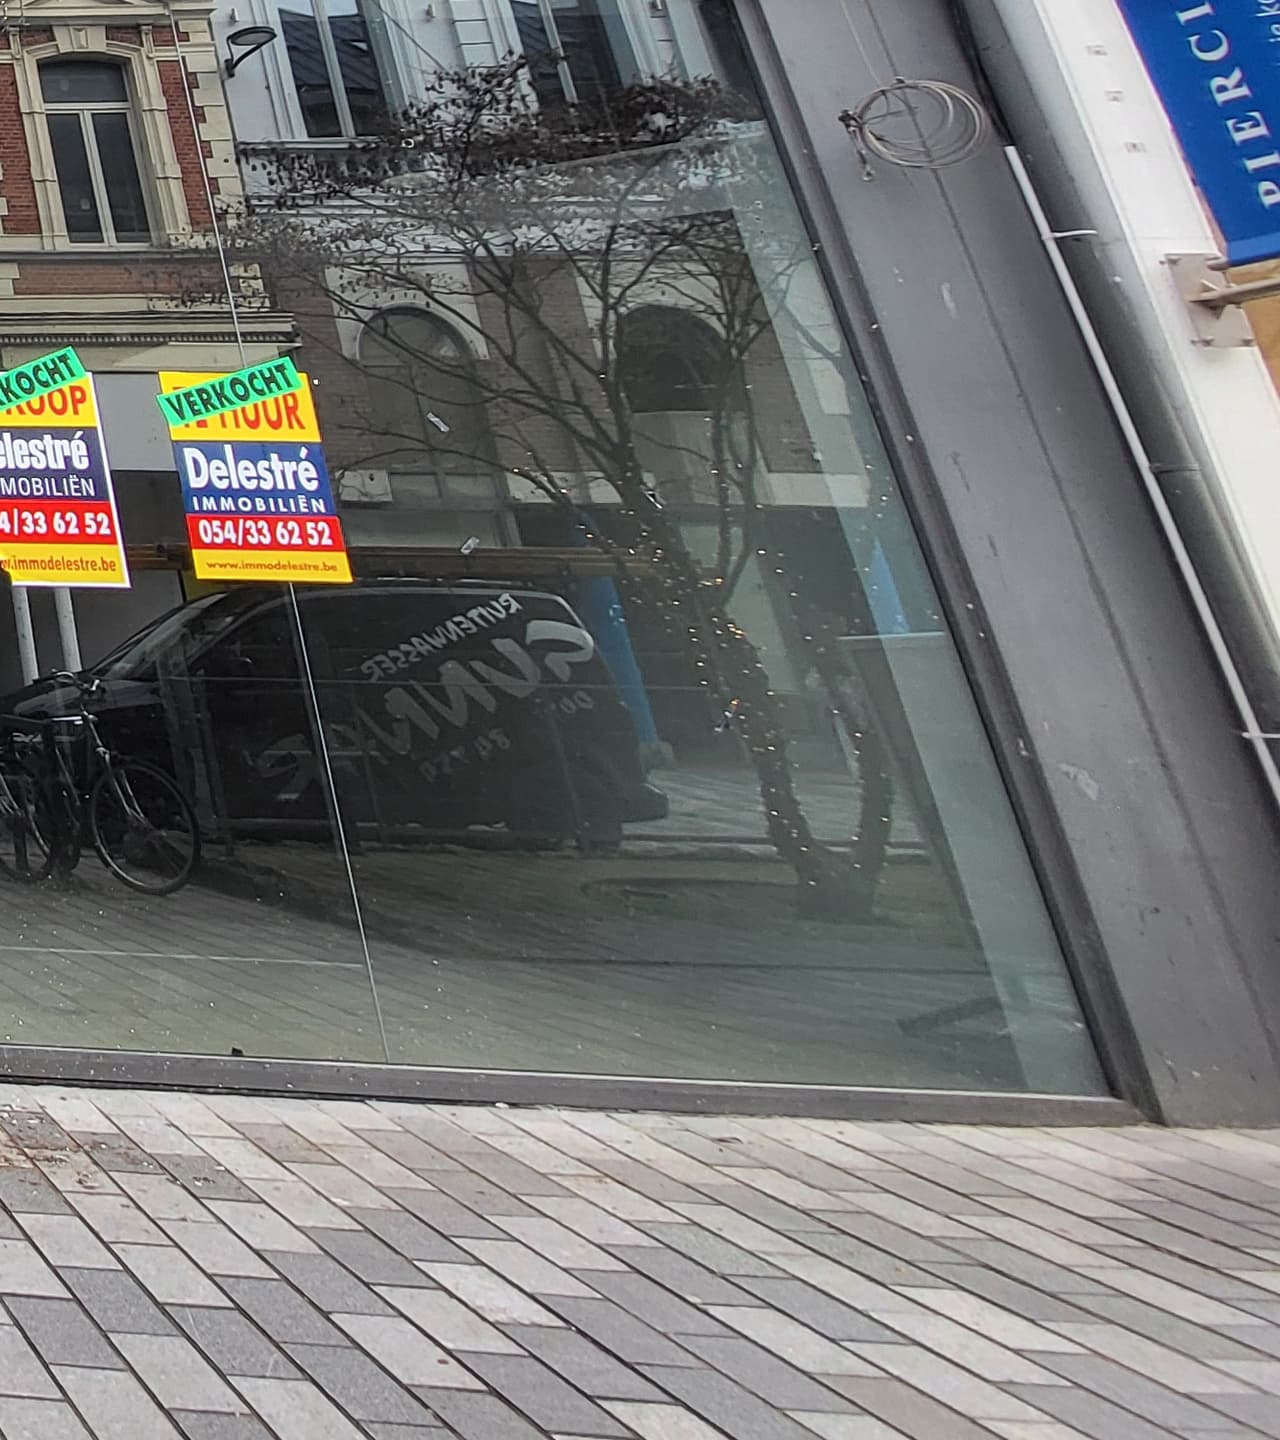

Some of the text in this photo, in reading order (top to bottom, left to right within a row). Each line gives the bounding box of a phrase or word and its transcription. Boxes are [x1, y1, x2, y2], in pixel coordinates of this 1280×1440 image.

[165, 363, 293, 421] VERKOCHT
[183, 444, 320, 492] Delestré
[192, 495, 326, 513] IMMOBILIËN
[53, 512, 79, 535] 62
[84, 512, 111, 536] 52
[198, 518, 333, 546] 054/33 62 52
[0, 554, 117, 572] w.immodelestre.be
[206, 560, 338, 573] www.immodelestre.be
